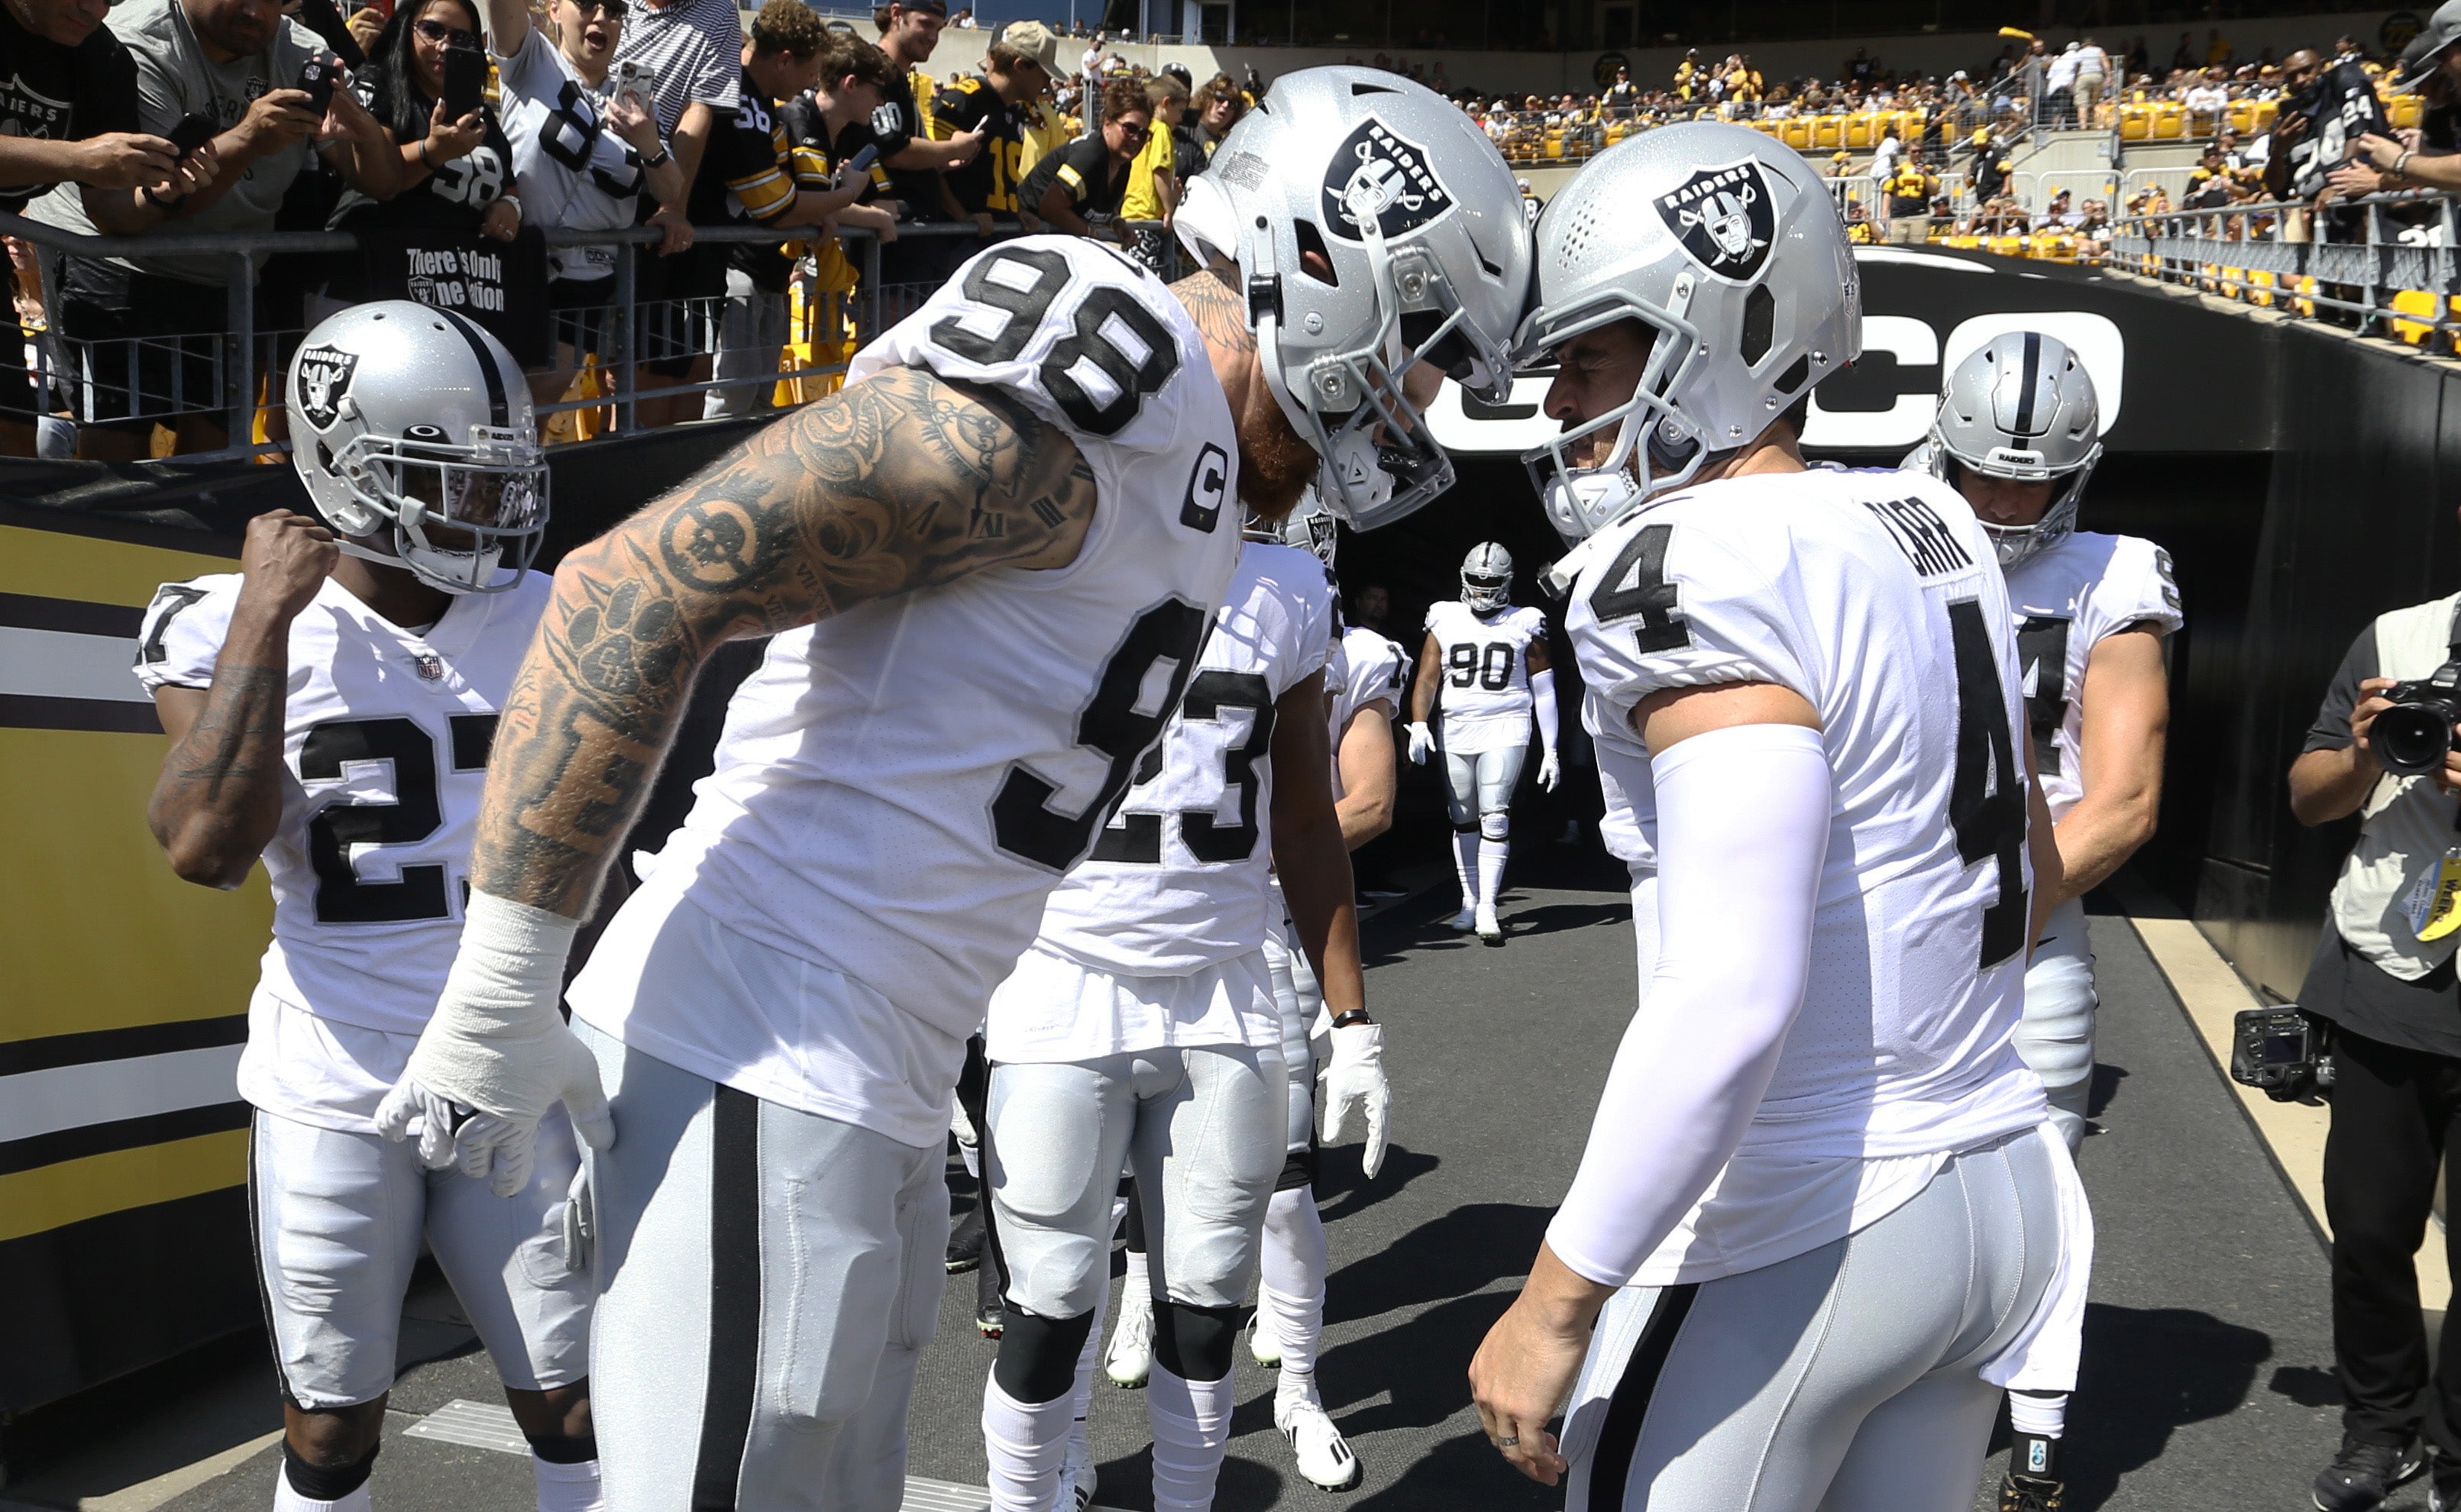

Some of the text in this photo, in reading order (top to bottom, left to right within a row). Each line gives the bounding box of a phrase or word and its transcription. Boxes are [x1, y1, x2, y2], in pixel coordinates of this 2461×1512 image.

[1368, 124, 1443, 202] RAIDERS
[1664, 165, 1751, 210] RAIDERS
[406, 247, 458, 276] There
[304, 349, 353, 365] RAIDERS
[929, 244, 1181, 437] 98
[1192, 464, 1225, 510] C
[1862, 496, 1974, 577] CARR
[1589, 521, 1691, 658] 4
[1449, 641, 1515, 691] 90
[1945, 597, 2029, 972] 4
